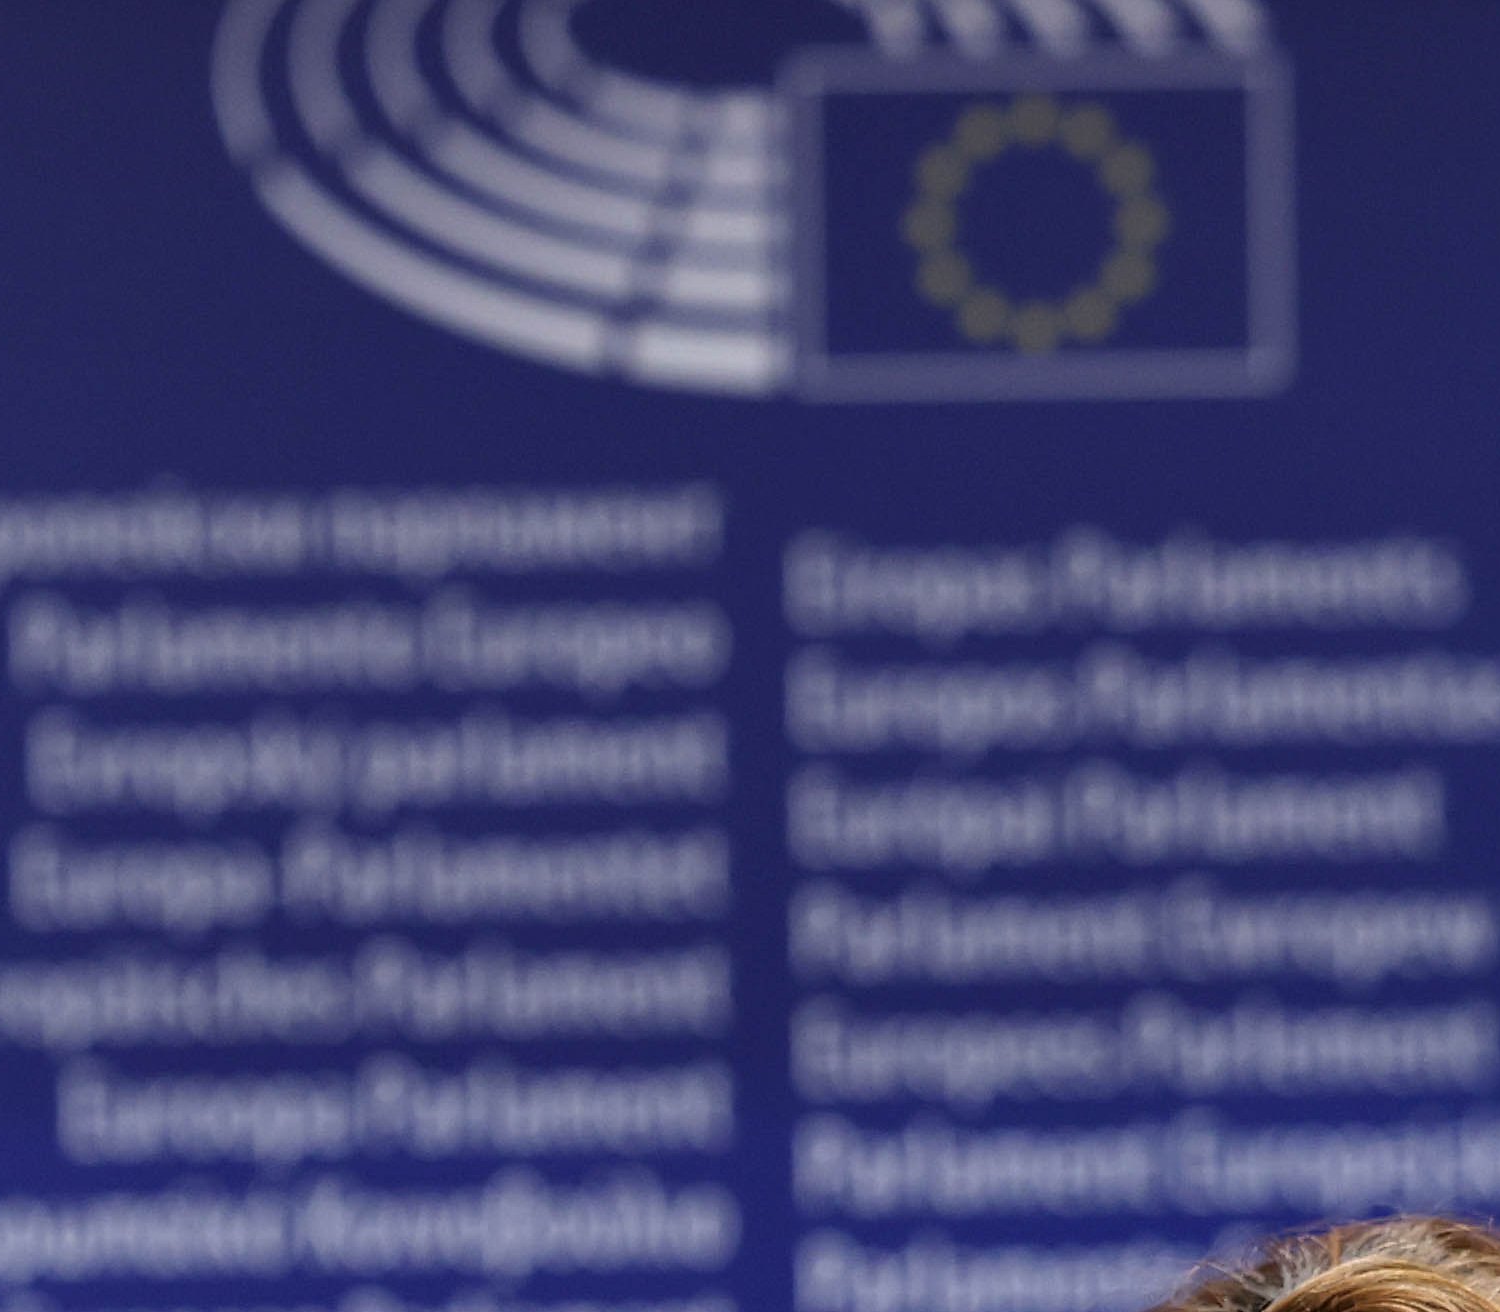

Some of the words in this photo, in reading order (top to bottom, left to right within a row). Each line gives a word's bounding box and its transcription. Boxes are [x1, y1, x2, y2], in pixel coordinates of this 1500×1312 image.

[319, 486, 723, 583] парламент
[793, 532, 1054, 644] Eiropas
[1058, 529, 1463, 627] Parlaments
[14, 593, 422, 691] Parlamento
[430, 589, 723, 704] Europeo
[33, 707, 352, 823] Evropský
[358, 702, 727, 823] parlament
[793, 650, 1082, 764] Europos
[794, 768, 1068, 881] Európai
[1072, 762, 1442, 860] Parlament
[17, 822, 727, 936] Europa-Parlamentet
[798, 883, 1165, 980] Parlament
[361, 937, 731, 1034] Parlament
[798, 998, 1126, 1113] Europees
[1129, 993, 1500, 1091] Parlement
[64, 1059, 356, 1176] Euroopa
[363, 1054, 733, 1152] Parlament
[800, 1117, 1170, 1214] Parlament
